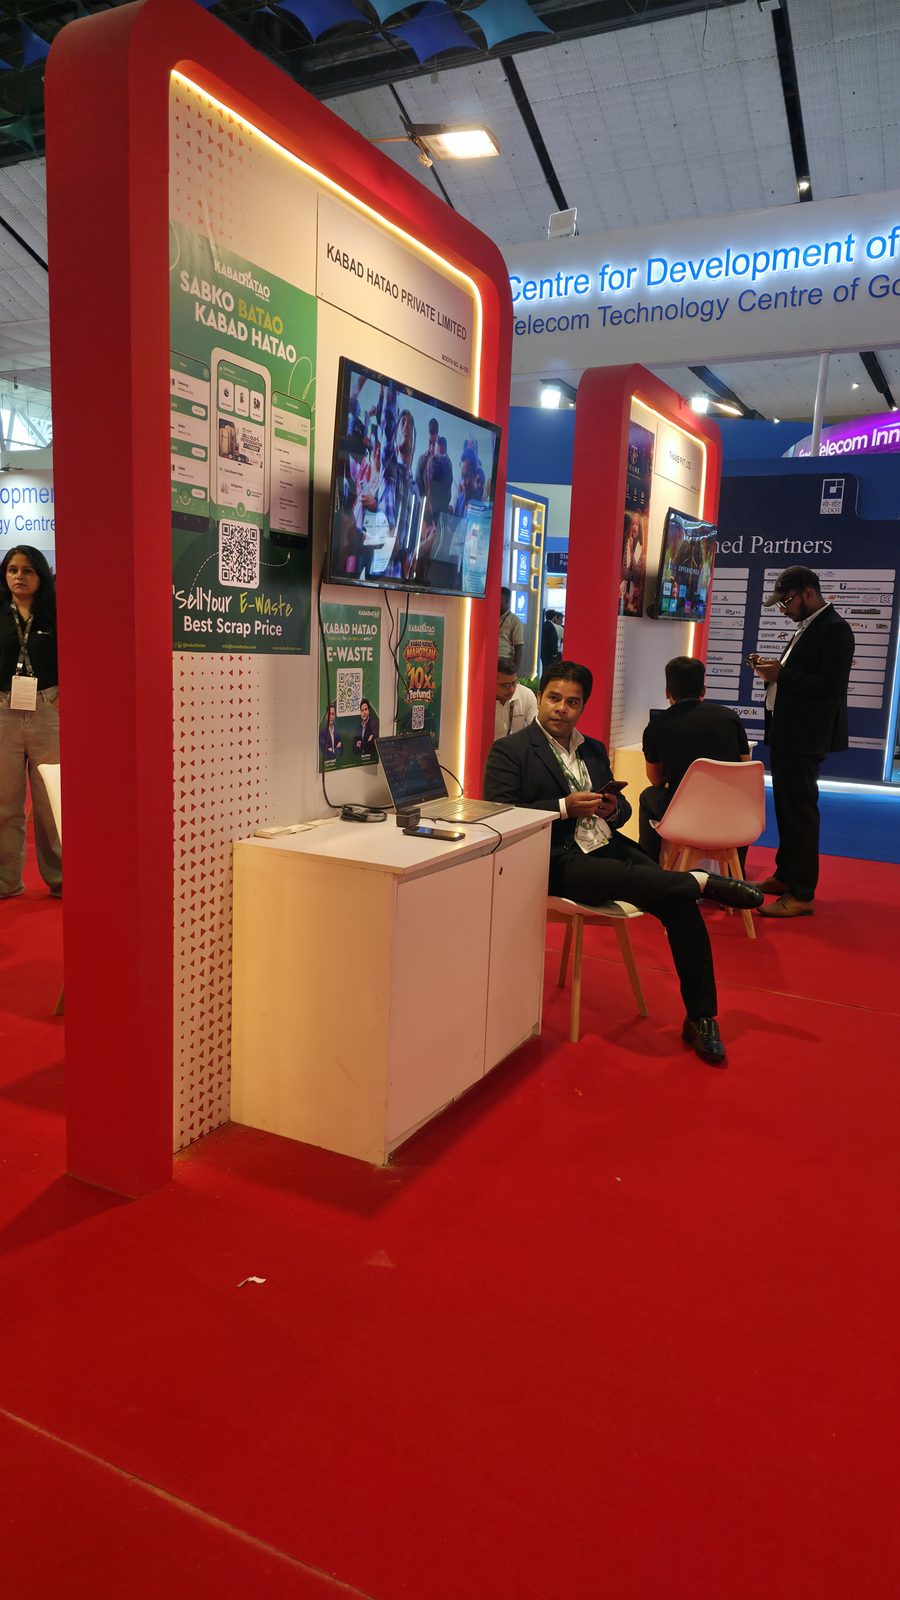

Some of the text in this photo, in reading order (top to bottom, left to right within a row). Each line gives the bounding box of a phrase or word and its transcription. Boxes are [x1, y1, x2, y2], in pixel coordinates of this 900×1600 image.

[509, 225, 900, 303] Centre for Development of
[180, 271, 283, 335] SABKO BATAO
[327, 243, 467, 340] KABAD HATAO PRIVATE LIMITED
[513, 313, 590, 336] elecom
[598, 296, 730, 327] Technology
[738, 286, 823, 312] Centre
[833, 277, 860, 303] of
[195, 303, 297, 363] KABAD HATAO
[819, 428, 900, 457] elecom Inn
[15, 515, 56, 531] Centre
[749, 535, 833, 554] Partners
[240, 592, 293, 617] E-Waste
[183, 615, 282, 638] Best Scrap Price
[323, 622, 378, 635] KABAD HATAO
[326, 646, 373, 662] E-WASTE
